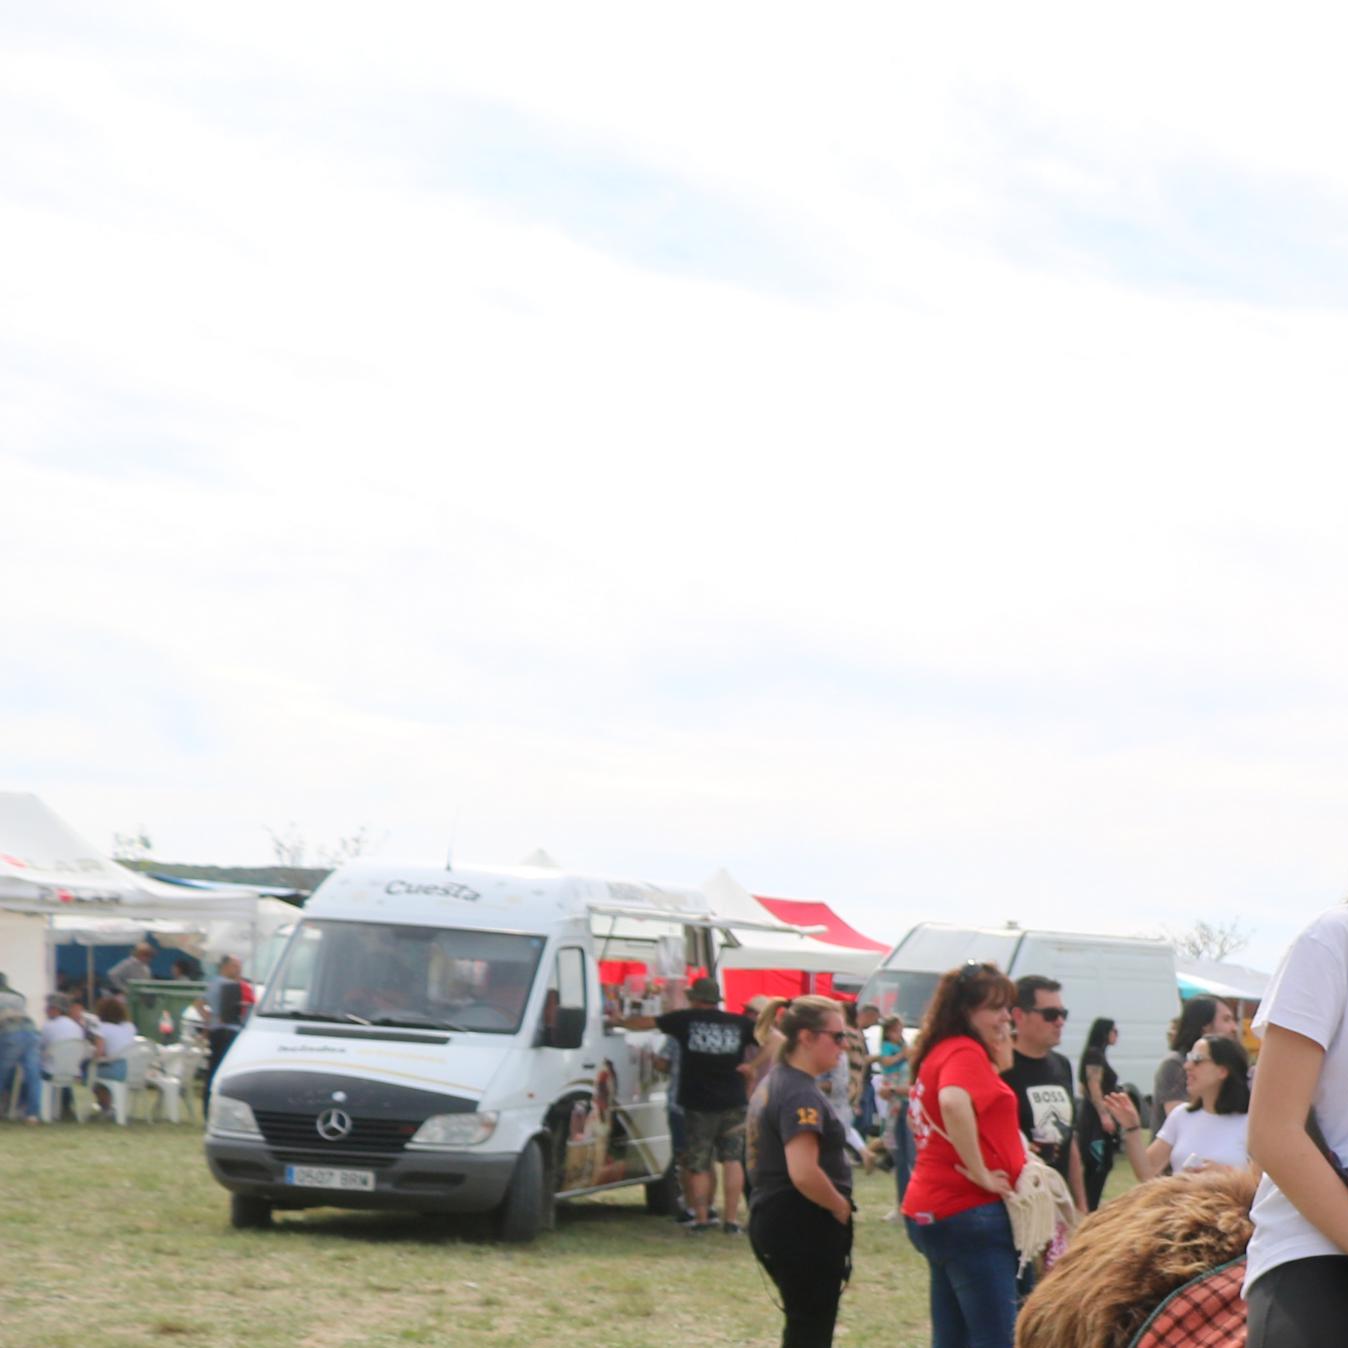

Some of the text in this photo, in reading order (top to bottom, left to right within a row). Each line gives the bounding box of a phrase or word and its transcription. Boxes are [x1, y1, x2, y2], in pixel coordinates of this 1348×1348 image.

[384, 879, 482, 902] Cuesta
[1031, 1091, 1066, 1104] BOSS
[796, 1106, 819, 1126] 12
